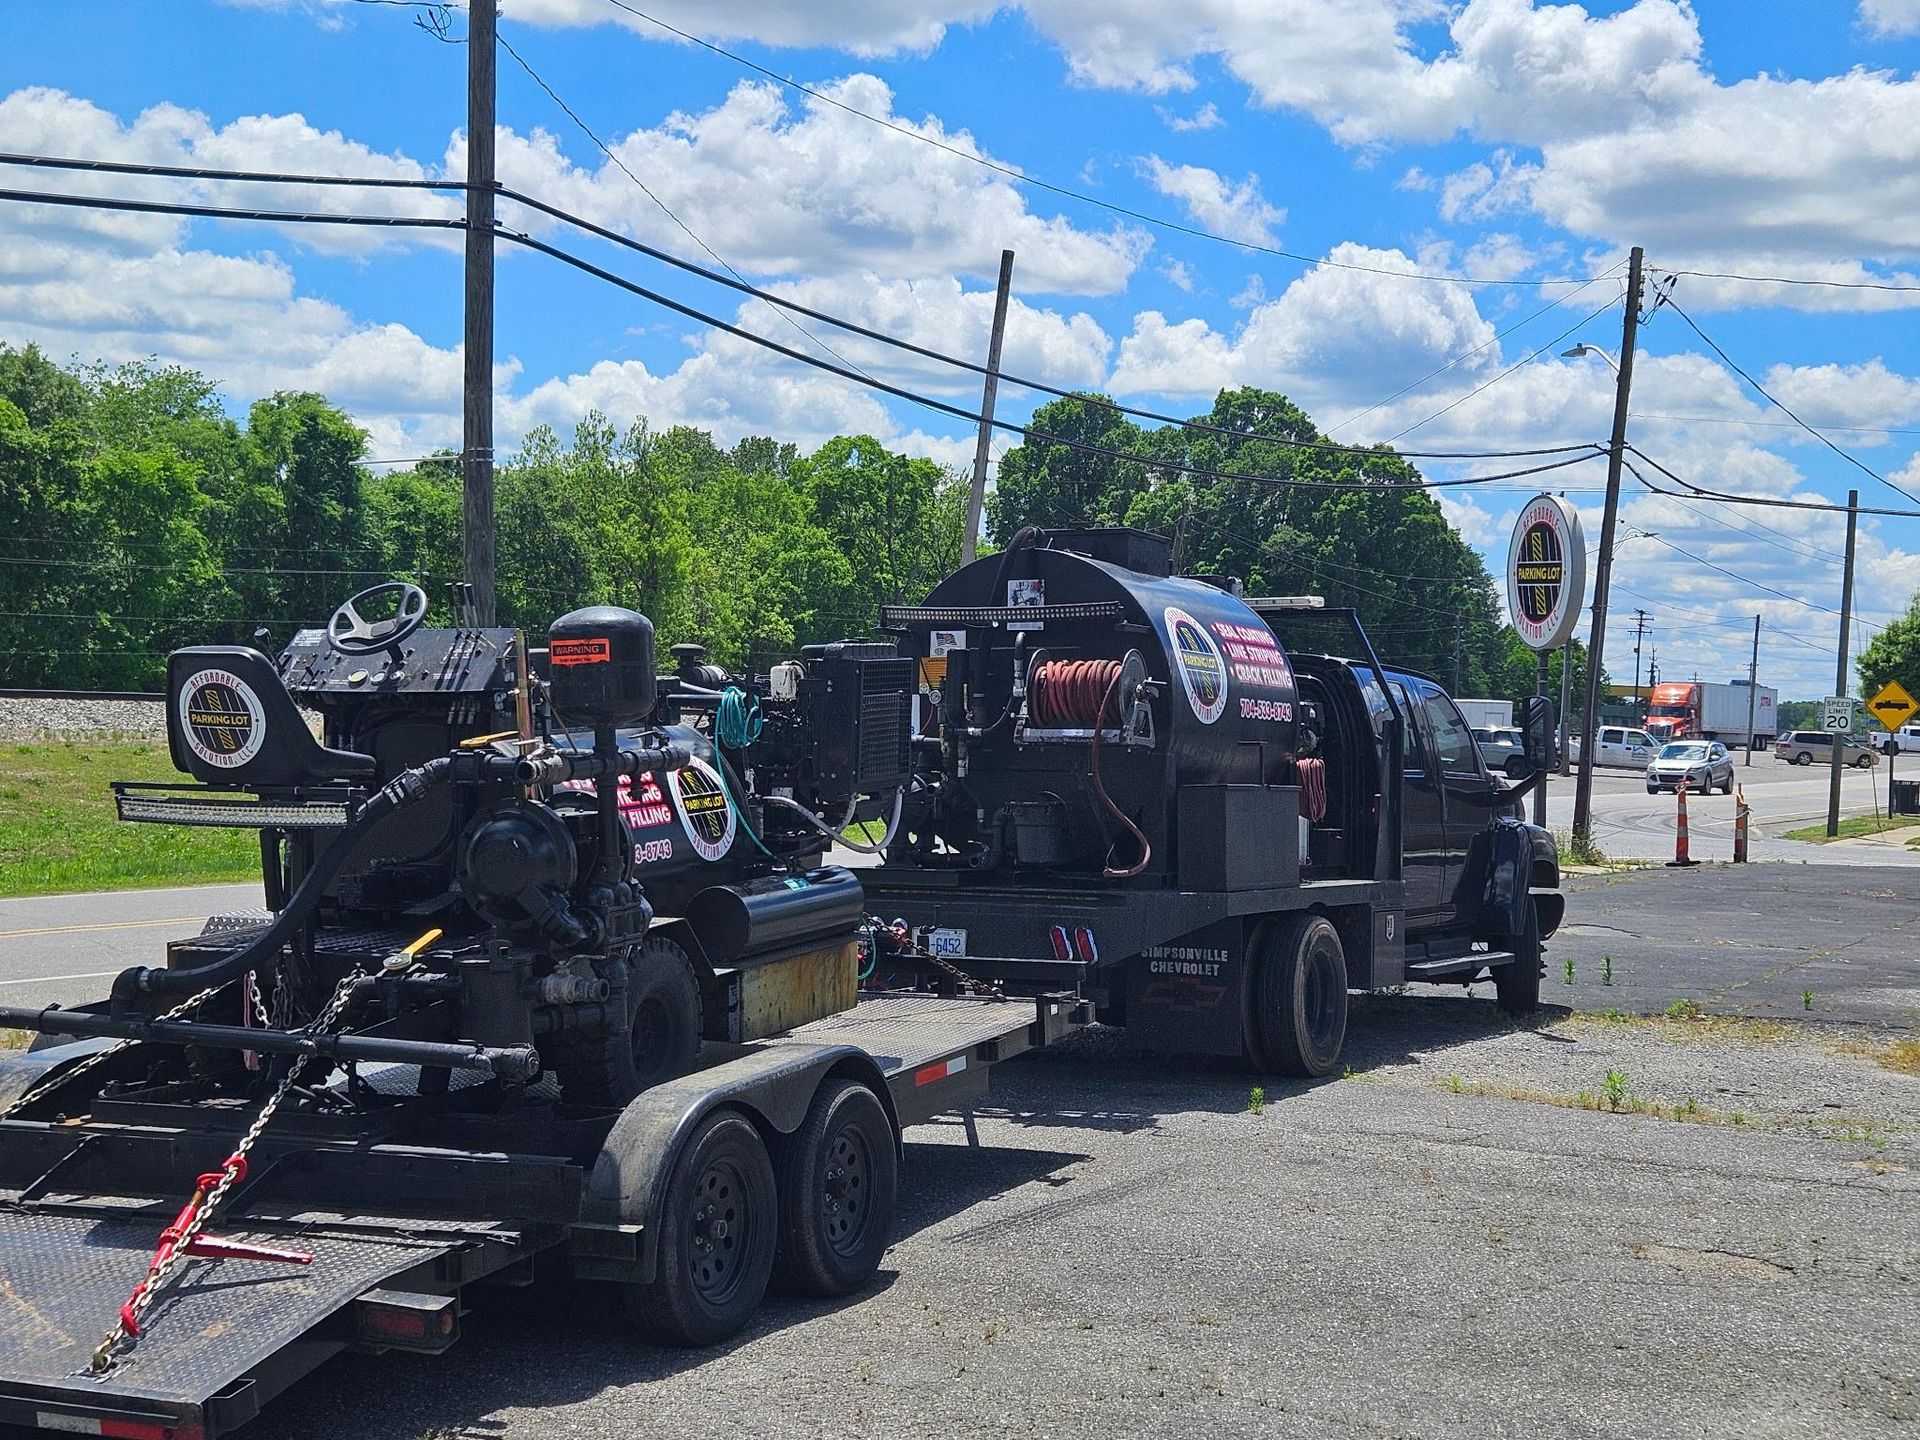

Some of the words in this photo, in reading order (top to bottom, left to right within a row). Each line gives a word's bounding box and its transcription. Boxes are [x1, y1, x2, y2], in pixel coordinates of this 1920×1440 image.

[1523, 506, 1559, 532] AFFORDABLE
[1518, 566, 1547, 580] PARKING
[1547, 566, 1561, 580] LOT
[1546, 609, 1559, 631] LLC
[1215, 622, 1239, 639] SEAL
[1235, 626, 1275, 646] COATING
[554, 645, 599, 655] WARNING
[1226, 642, 1248, 659] LINE
[1246, 645, 1284, 666] STRIPING
[190, 672, 241, 690] AFFORDABLE
[1235, 663, 1263, 683] CRACK
[1261, 667, 1293, 688] FILLING
[1239, 698, 1292, 722] 704-533-8743
[191, 714, 230, 724] PARKING
[231, 716, 249, 725] LOT
[1827, 715, 1848, 729] 20
[238, 745, 254, 761] LLC
[685, 797, 712, 811] PARKING
[711, 795, 724, 807] LOT
[629, 806, 671, 828] FILLING
[634, 838, 672, 864] 3-8743
[929, 937, 961, 954] -6452
[1141, 946, 1228, 961] SIMPSONVILLE
[1150, 961, 1220, 976] CHEVROLET
